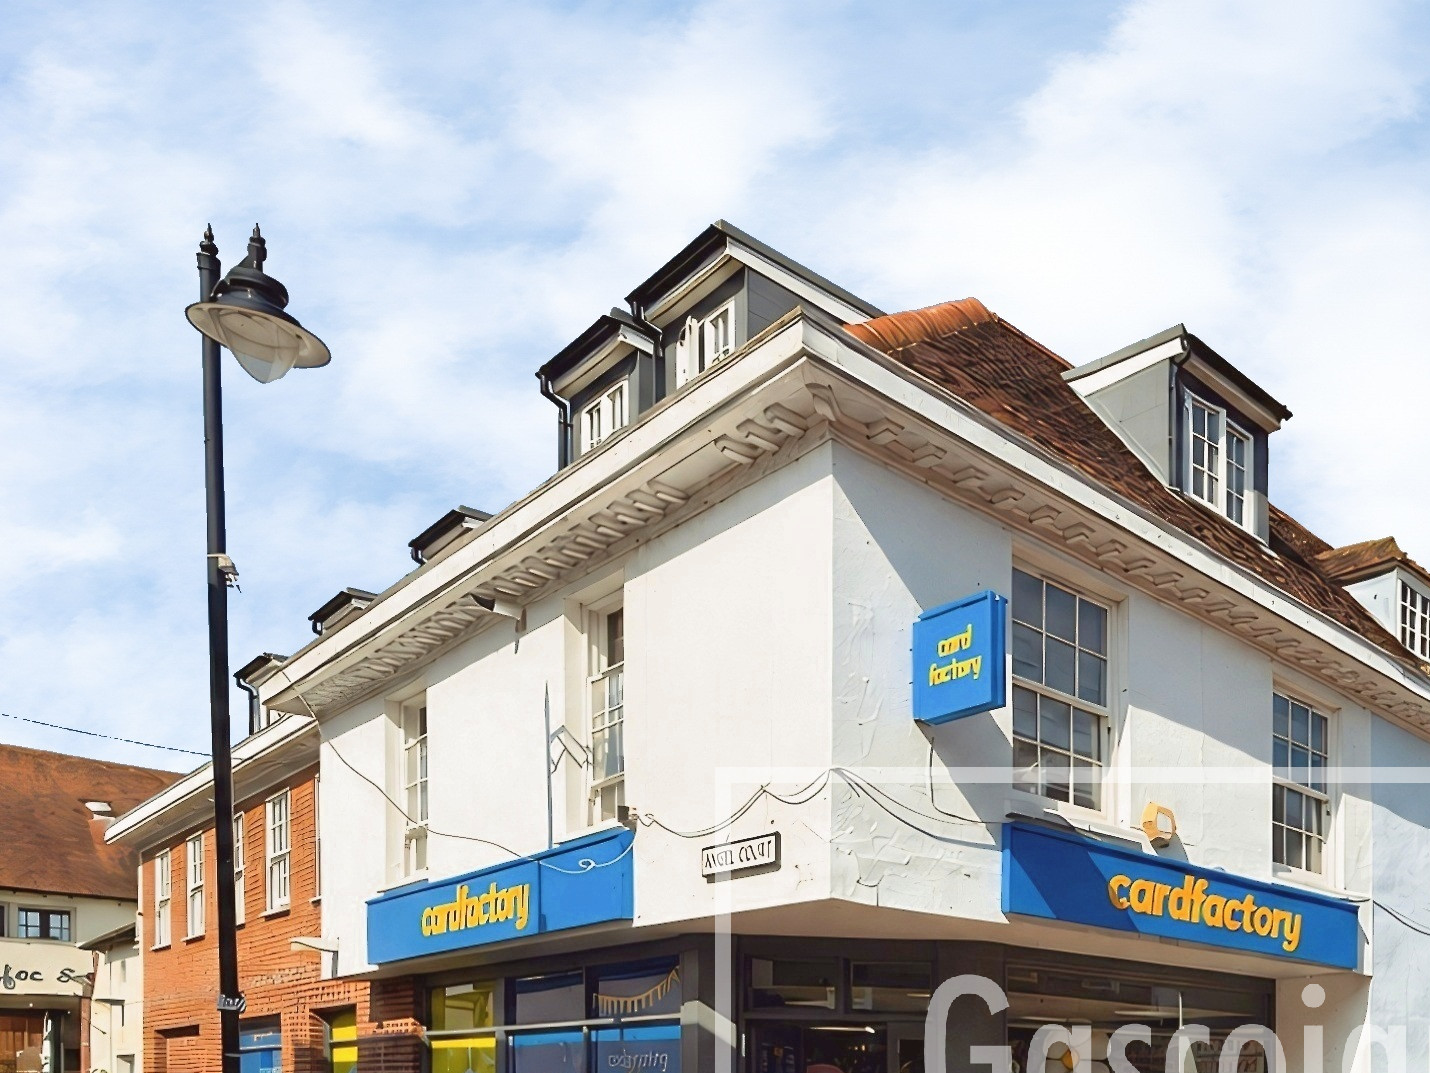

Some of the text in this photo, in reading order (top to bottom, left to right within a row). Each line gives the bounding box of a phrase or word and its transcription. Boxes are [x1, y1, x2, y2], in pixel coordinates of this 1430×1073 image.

[937, 623, 973, 658] card
[929, 655, 982, 687] factory
[421, 881, 530, 937] cardfactory
[1108, 873, 1302, 953] cardfactory
